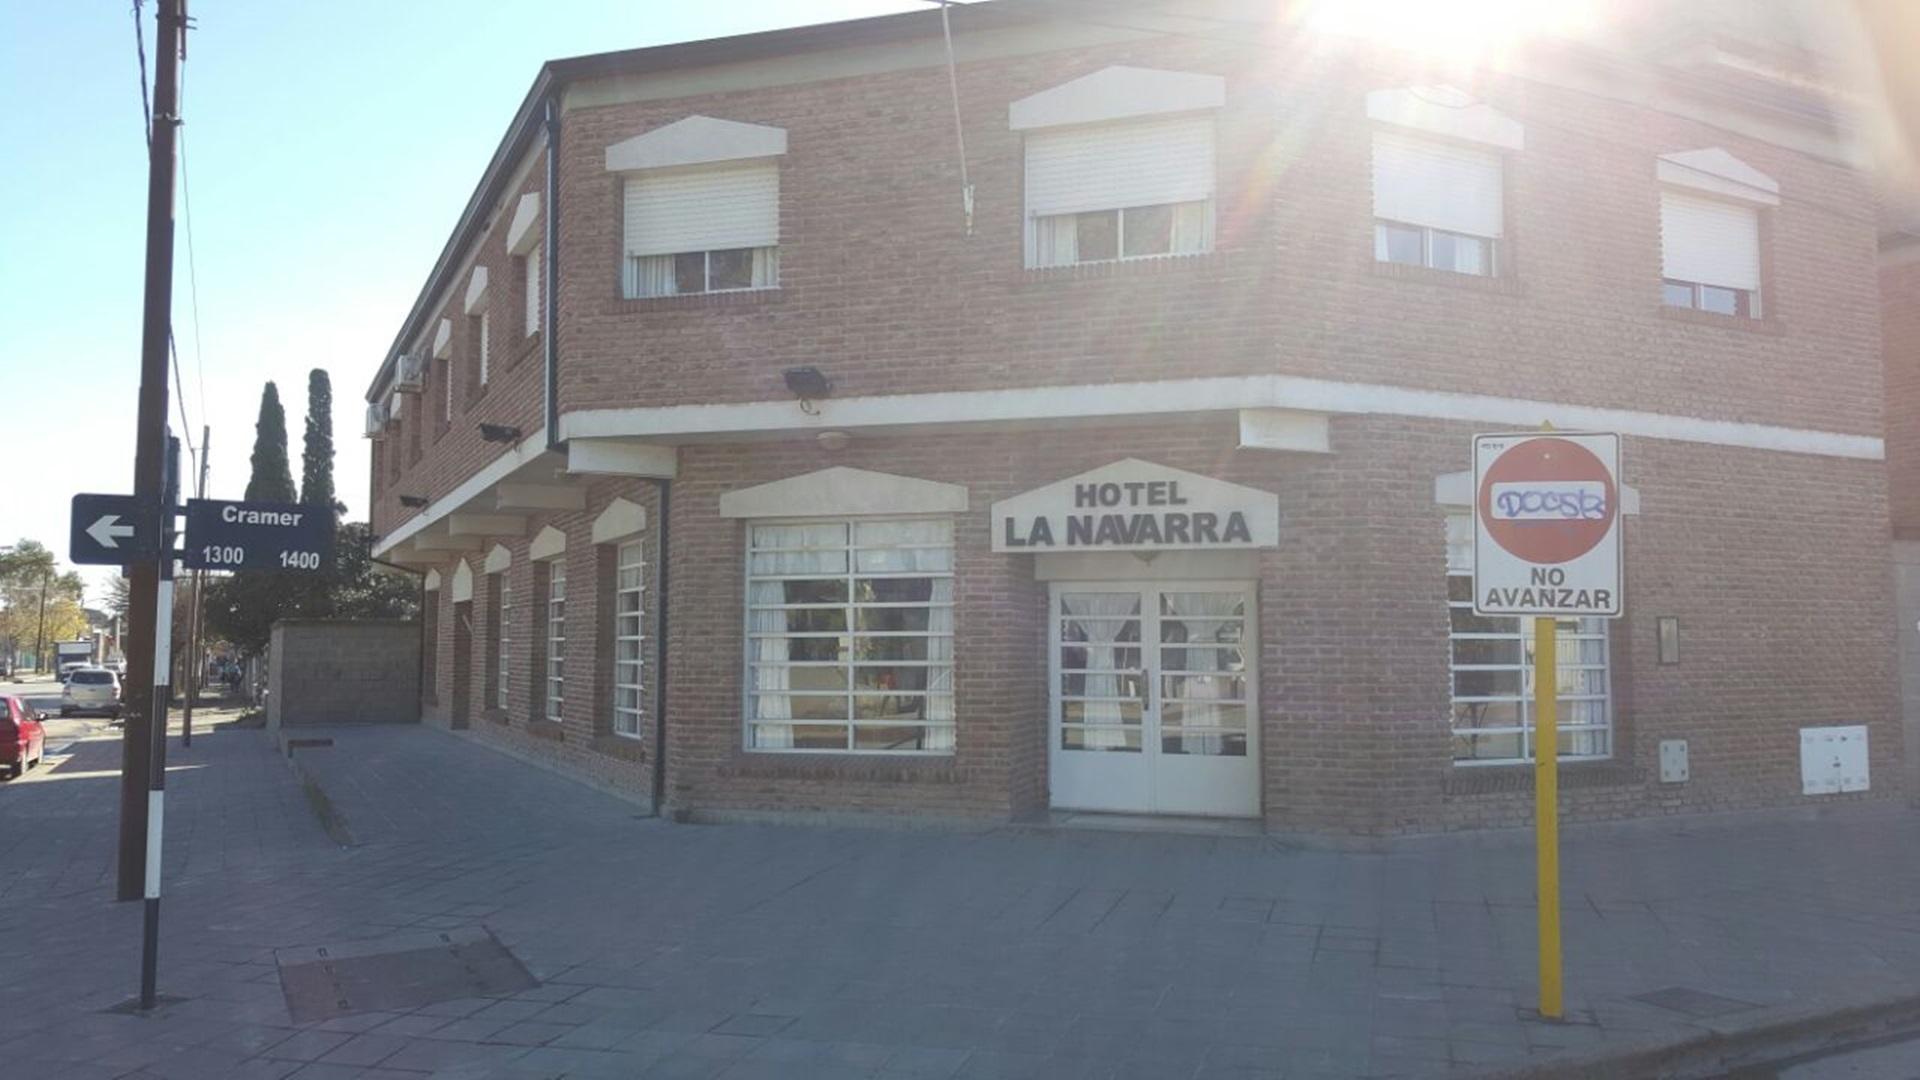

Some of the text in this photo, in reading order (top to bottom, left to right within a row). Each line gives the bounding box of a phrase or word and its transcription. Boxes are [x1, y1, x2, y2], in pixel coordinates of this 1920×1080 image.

[1076, 482, 1187, 507] HOTEL
[222, 505, 302, 526] Cramer
[1005, 511, 1252, 547] LA NAVARRA
[202, 546, 320, 570] 1300 1400
[1531, 567, 1565, 586] NO
[1485, 588, 1611, 609] AVANZAR
